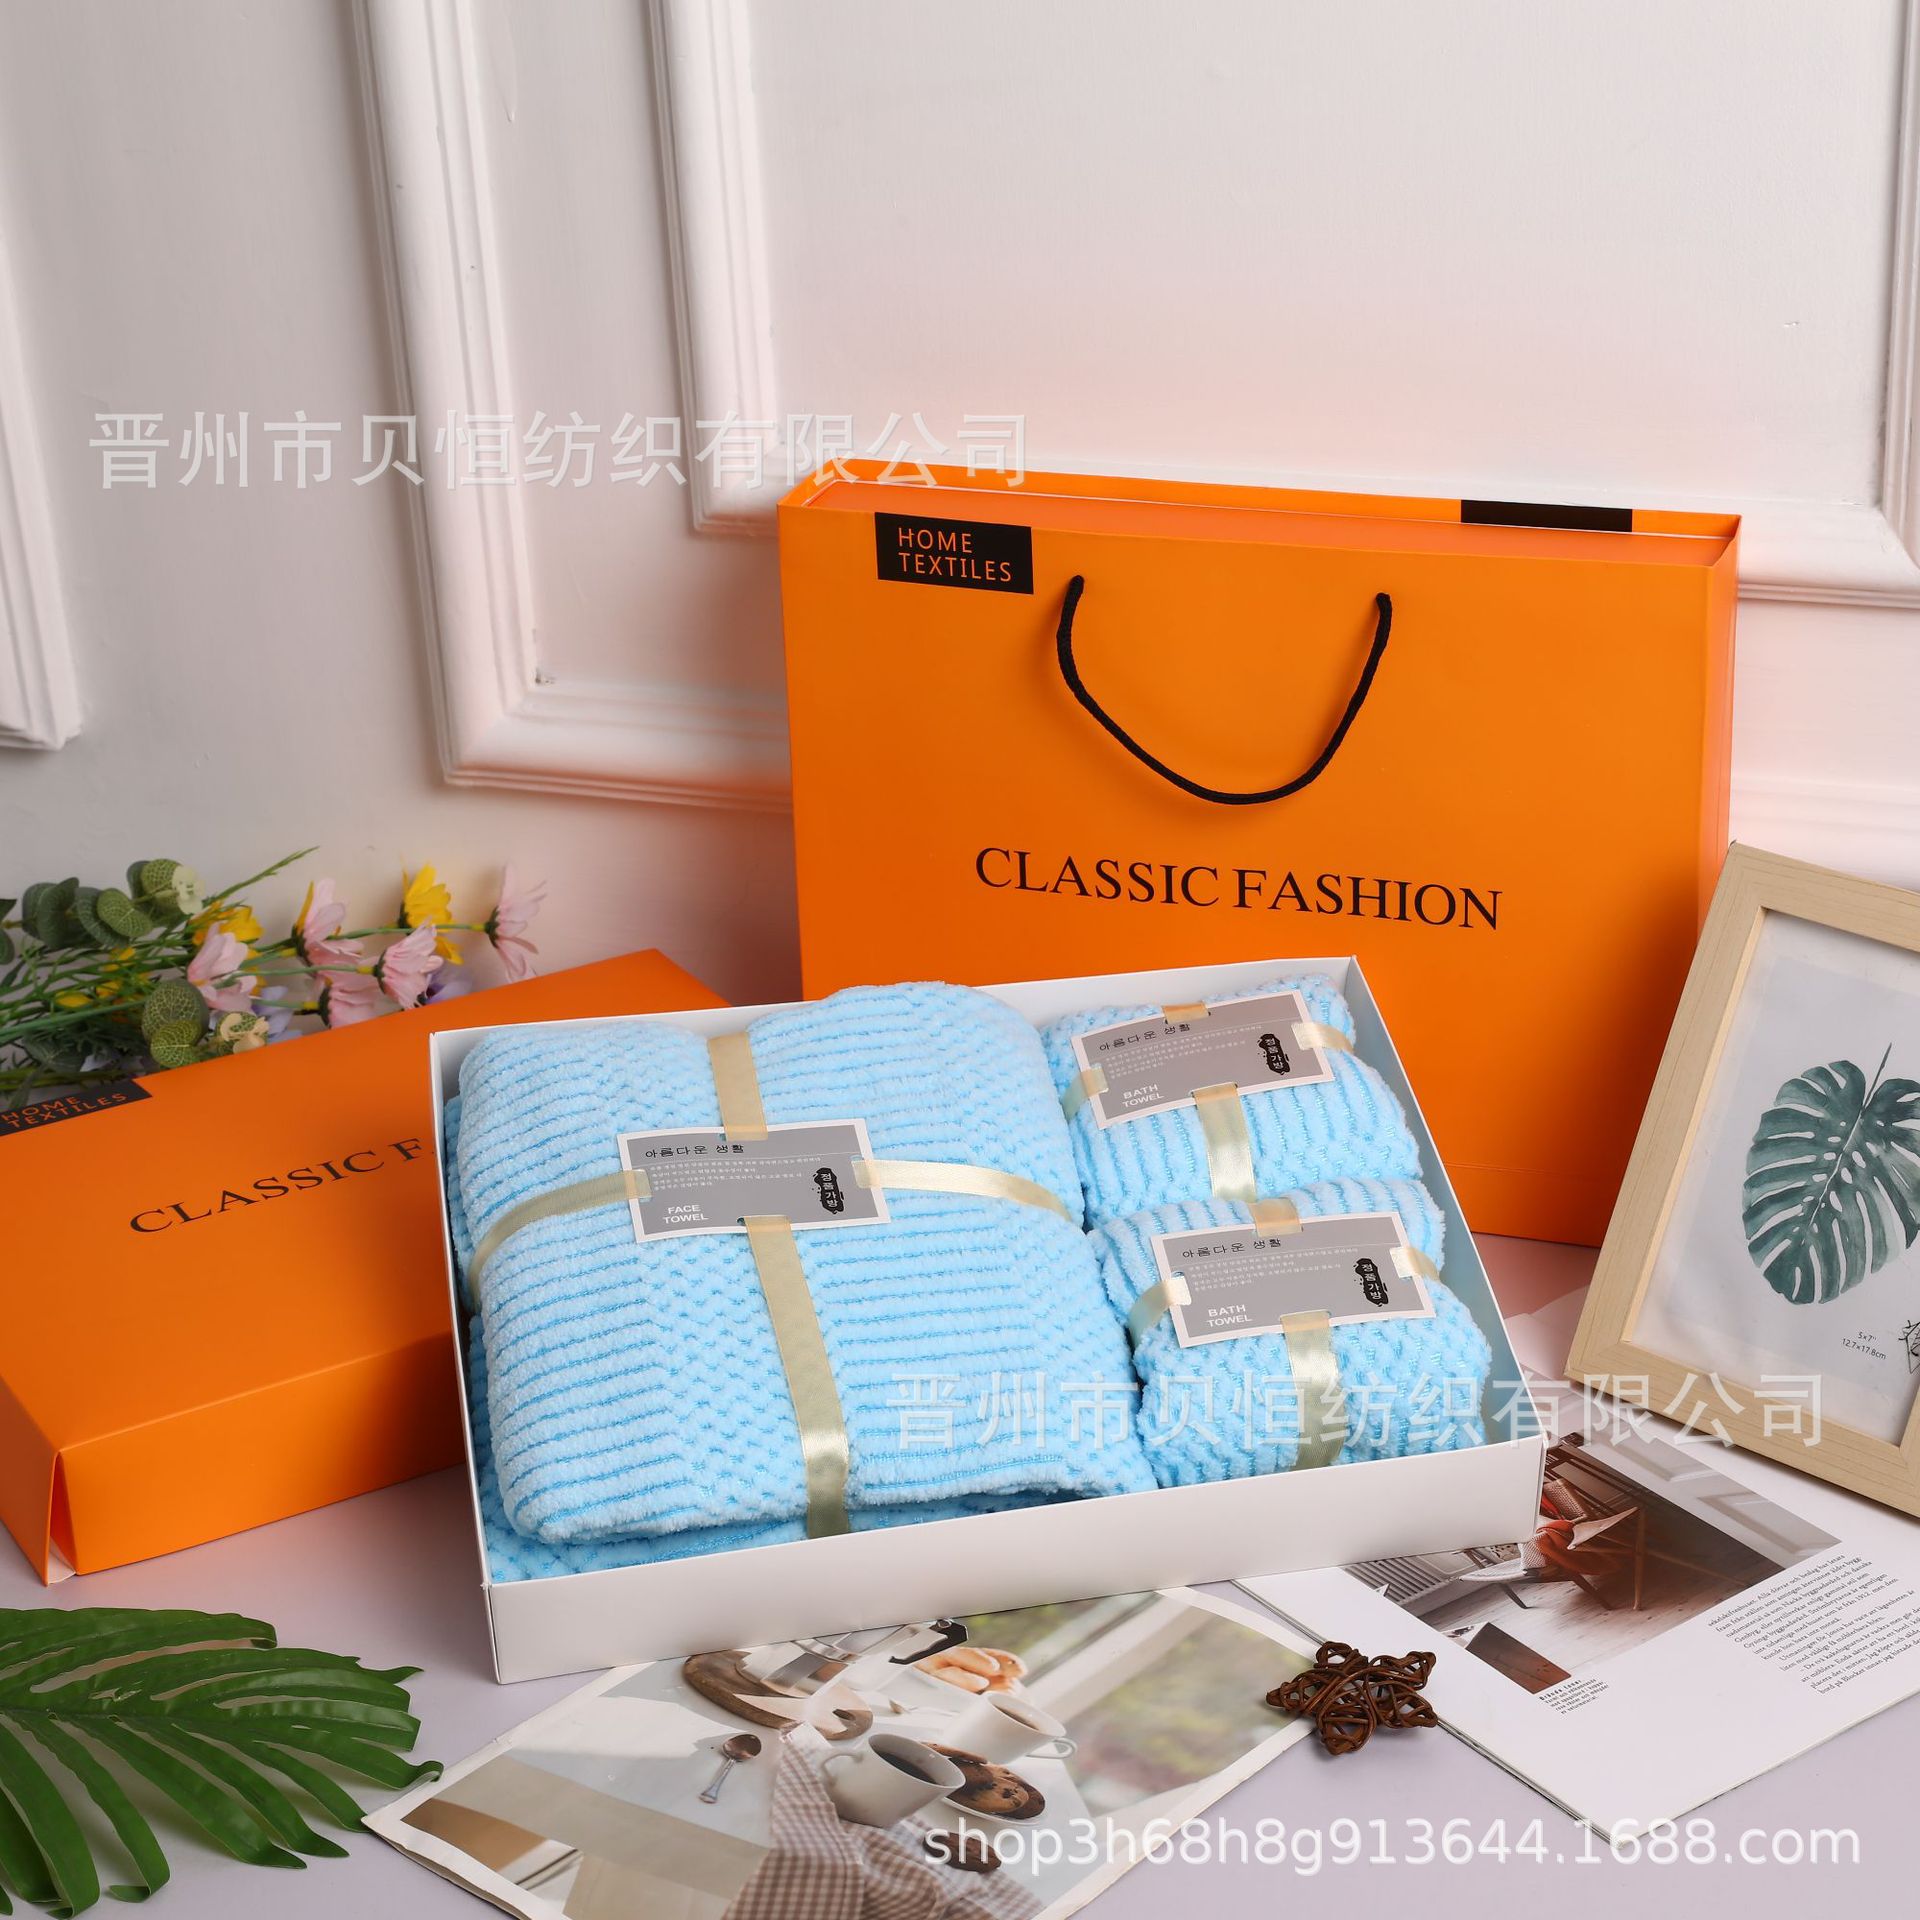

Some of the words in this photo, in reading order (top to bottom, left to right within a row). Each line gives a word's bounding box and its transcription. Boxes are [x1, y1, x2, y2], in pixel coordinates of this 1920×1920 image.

[898, 526, 973, 554] HOME
[898, 552, 1013, 584] TEXTILES
[975, 846, 1220, 908] CLASSIC
[1232, 869, 1502, 931] FASHION
[1124, 1084, 1158, 1099] BATH
[1122, 1092, 1164, 1108] TOWEL
[1, 1095, 80, 1122] HOME
[7, 1092, 129, 1129] TEXTILES
[645, 1145, 708, 1159] 아름다운
[129, 1150, 385, 1233] CLASSIC
[668, 1204, 701, 1214] FACE
[662, 1214, 708, 1224] TOWEL
[1183, 1242, 1245, 1259] 아름다운
[1208, 1304, 1245, 1317] BATH
[1207, 1315, 1252, 1327] TOWEL
